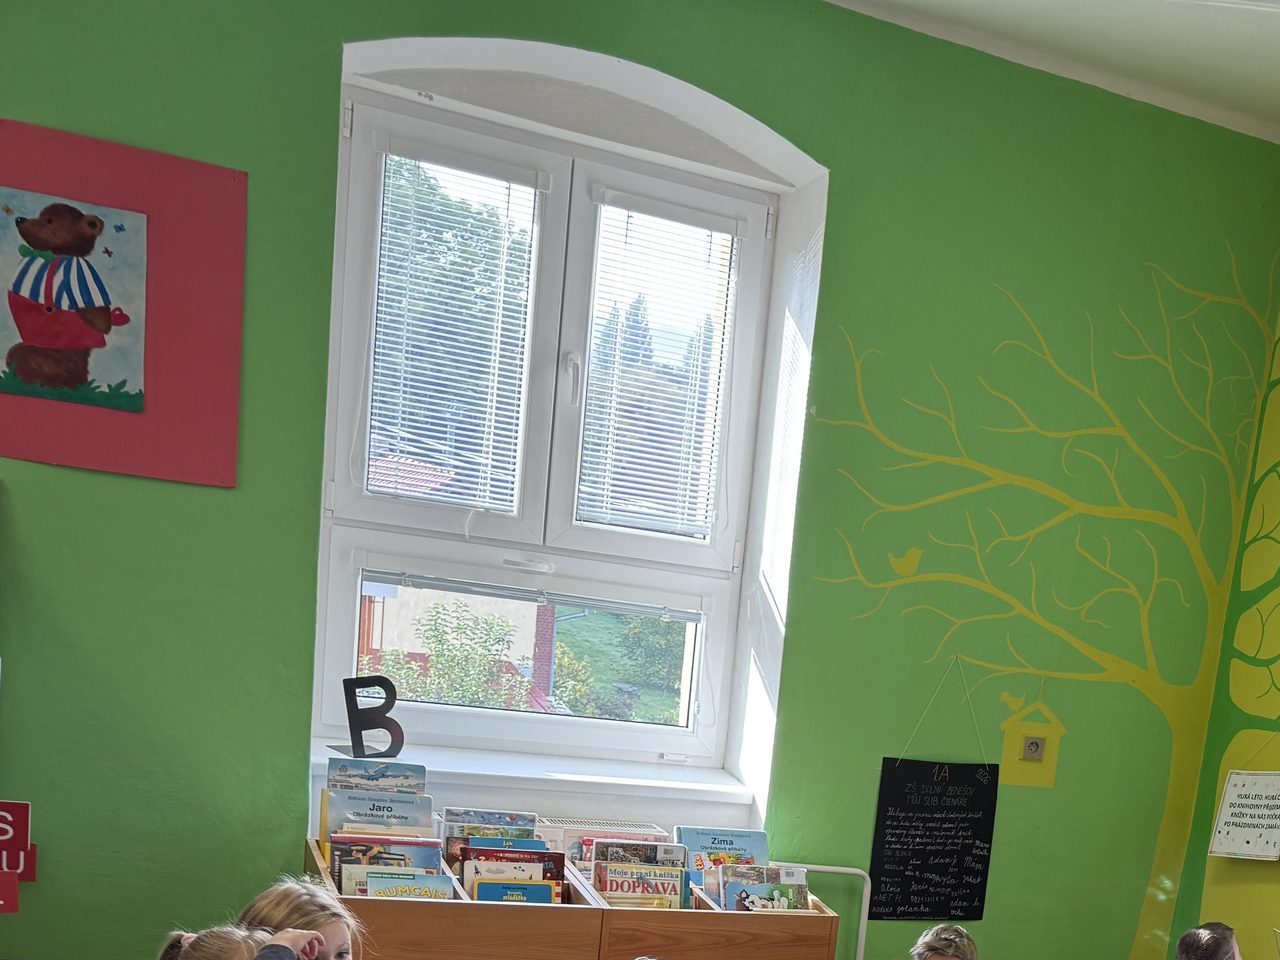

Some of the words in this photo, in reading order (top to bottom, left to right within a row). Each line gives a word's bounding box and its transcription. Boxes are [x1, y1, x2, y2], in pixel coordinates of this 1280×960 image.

[343, 675, 404, 758] B
[369, 804, 393, 813] Jaro
[711, 837, 734, 846] Zima
[609, 867, 628, 876] Moje
[631, 869, 652, 879] první
[654, 869, 679, 879] knížka
[609, 879, 679, 896] DOPRAVA
